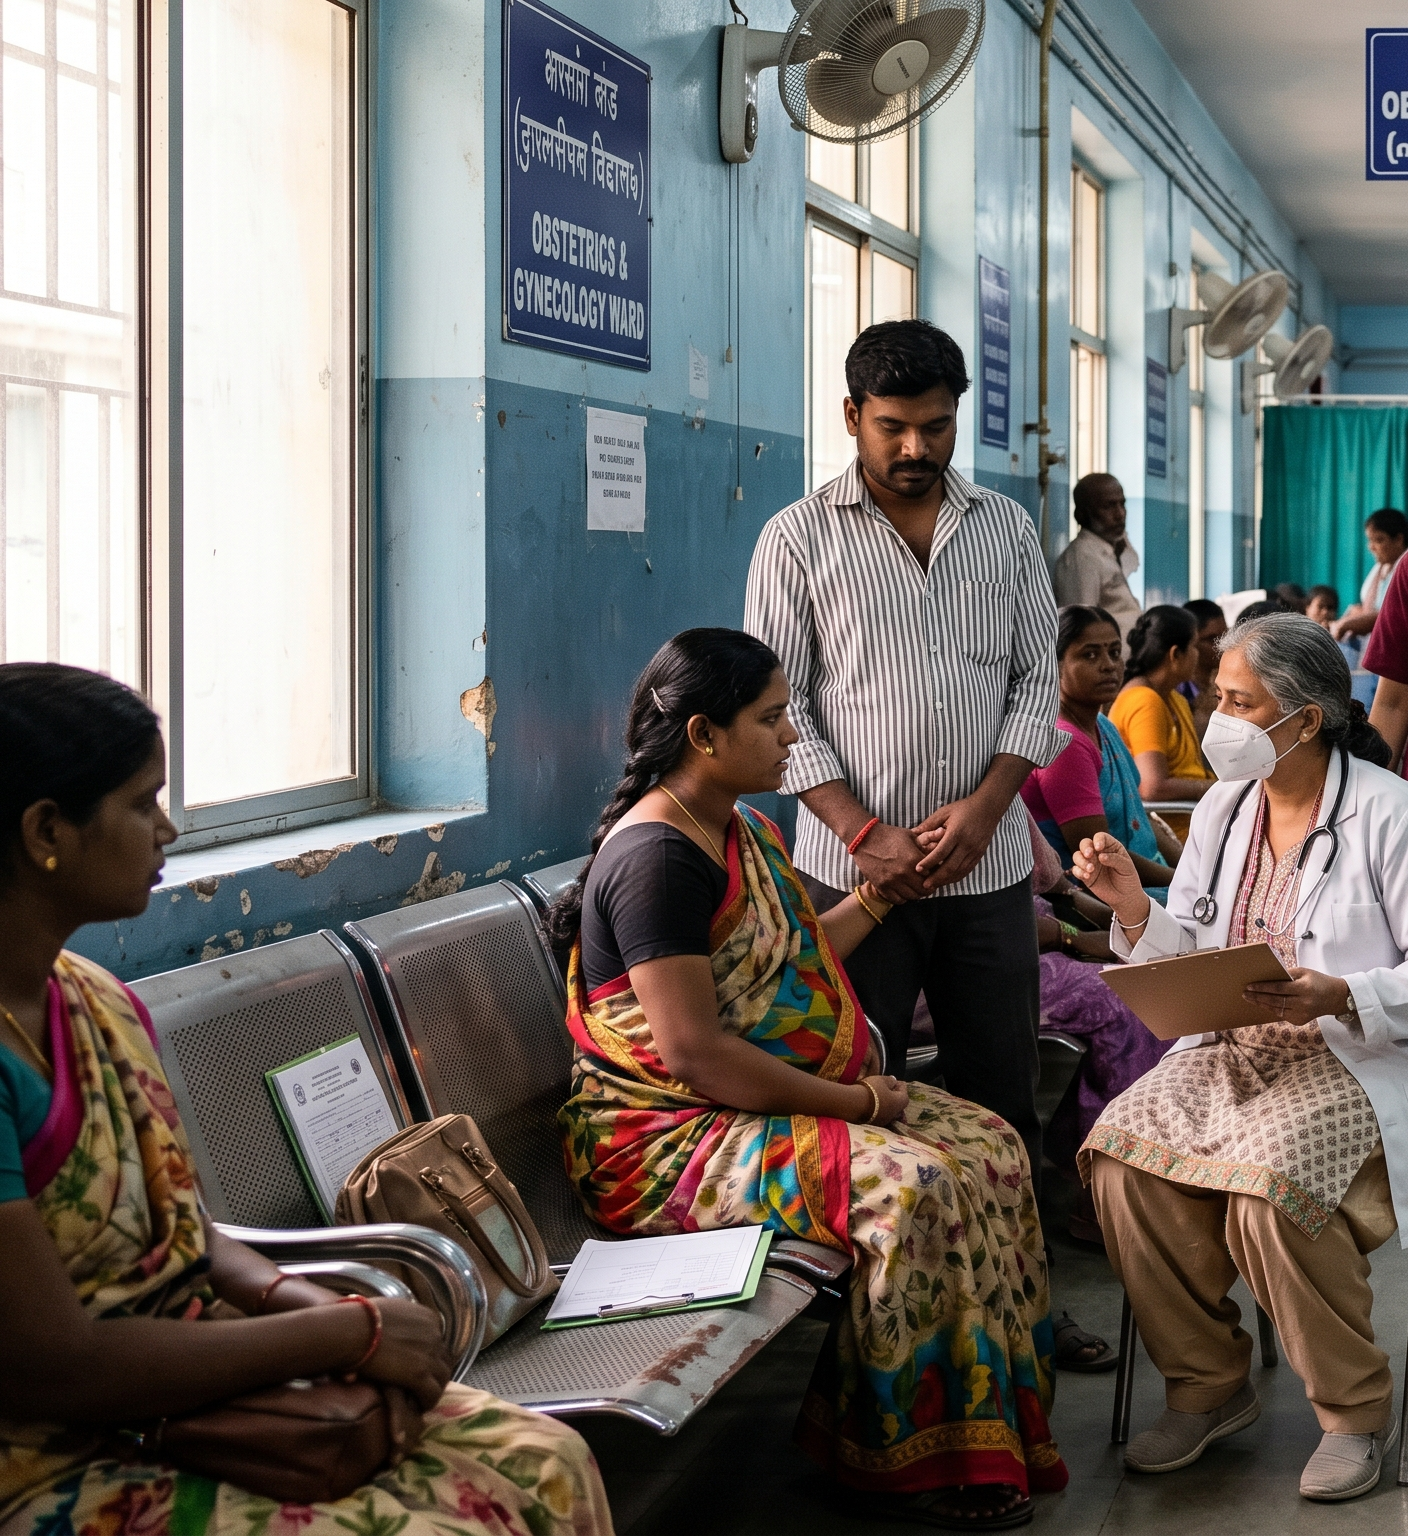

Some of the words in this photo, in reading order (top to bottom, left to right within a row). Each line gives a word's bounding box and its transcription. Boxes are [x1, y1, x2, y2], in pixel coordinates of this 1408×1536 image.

[532, 210, 616, 278] OBSTETRICS
[618, 240, 628, 281] &
[513, 267, 607, 331] GYNECOLOGY
[608, 294, 645, 341] WARD
